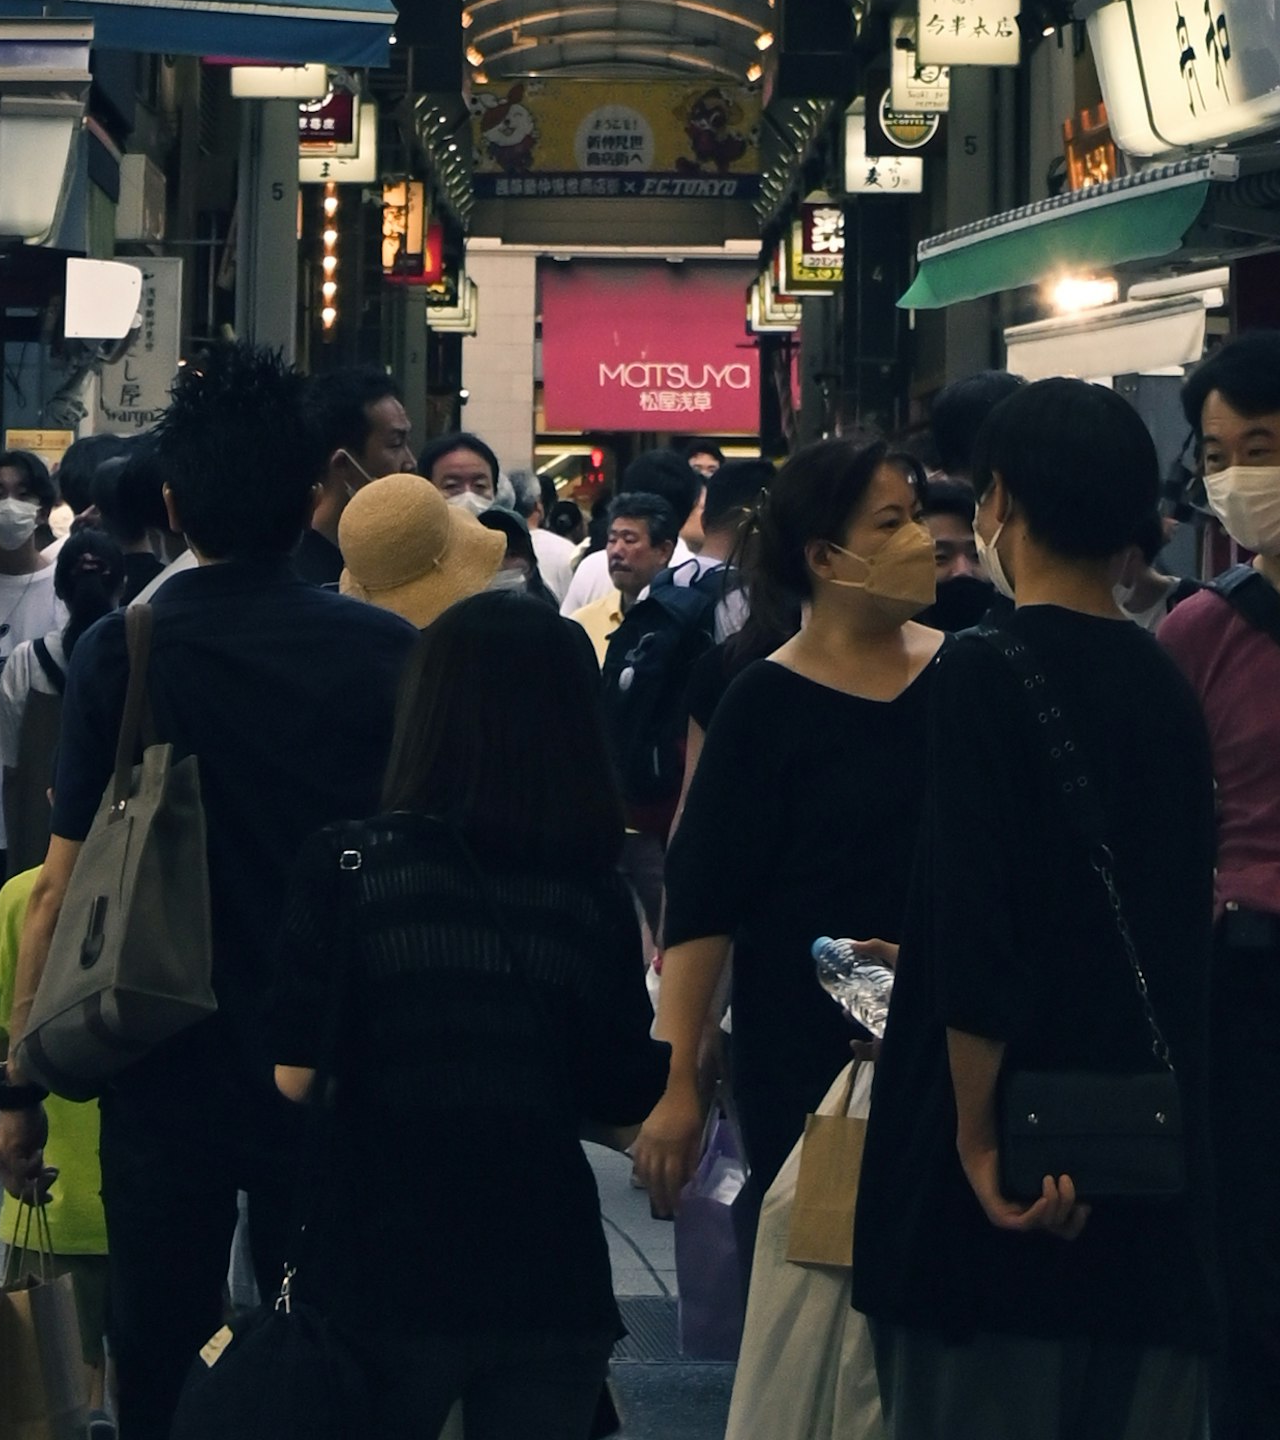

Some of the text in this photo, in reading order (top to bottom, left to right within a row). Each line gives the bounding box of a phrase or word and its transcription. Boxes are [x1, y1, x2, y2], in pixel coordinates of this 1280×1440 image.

[926, 14, 1014, 37] 今半本店
[587, 135, 644, 150] 新仲見世
[964, 136, 977, 155] 5
[272, 182, 284, 201] 5
[640, 391, 713, 412] 松屋浅草
